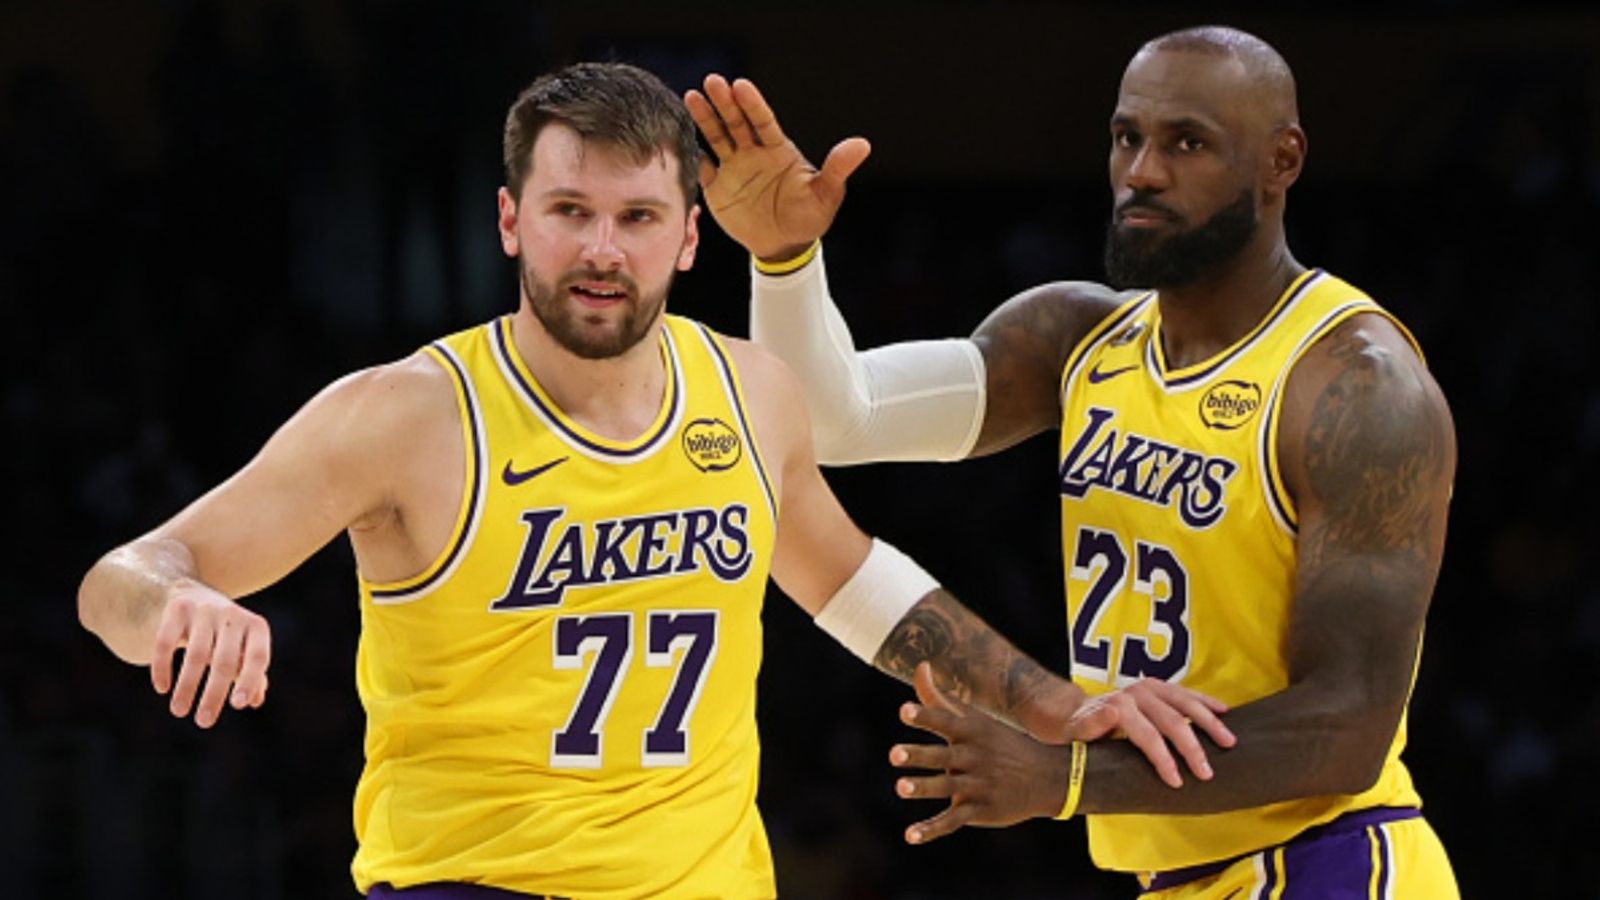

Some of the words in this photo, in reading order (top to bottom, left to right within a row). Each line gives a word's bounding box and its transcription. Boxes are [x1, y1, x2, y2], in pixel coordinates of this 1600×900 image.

[687, 431, 739, 454] bibigo
[1207, 391, 1259, 416] bibigo
[1060, 407, 1238, 529] LAKERS
[488, 503, 752, 611] LAKERS
[1070, 527, 1191, 685] 23
[550, 610, 720, 768] 77
